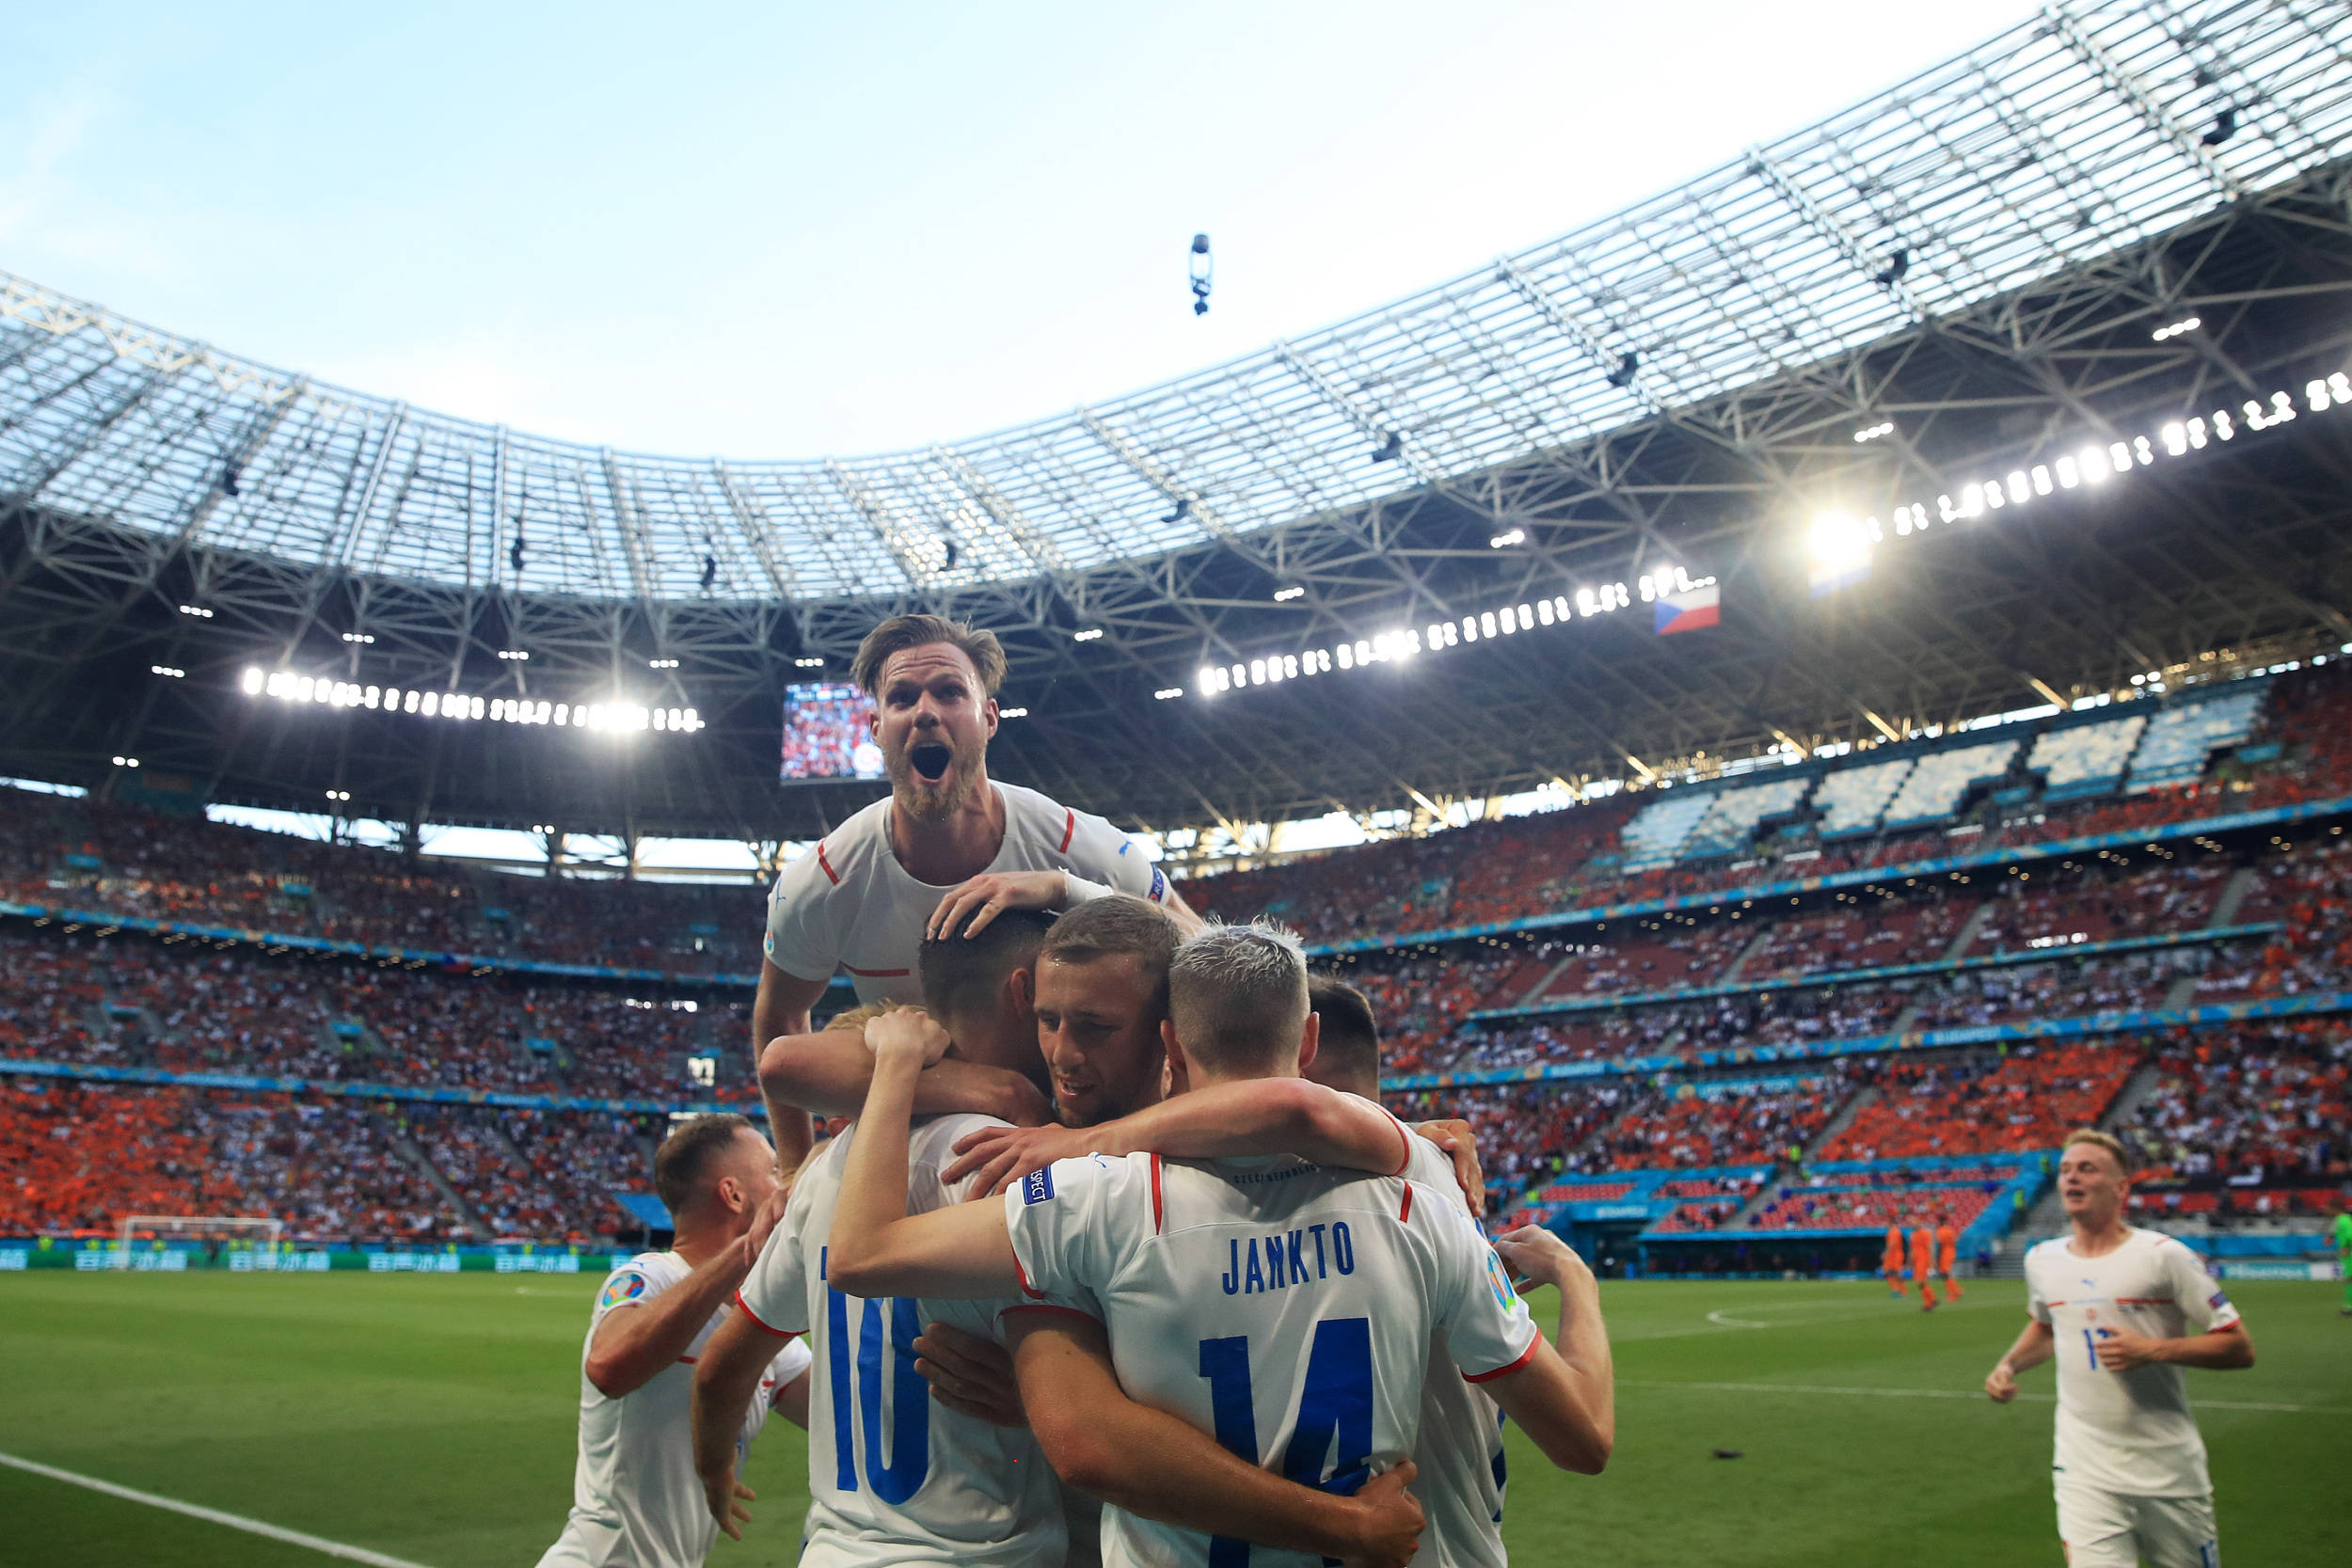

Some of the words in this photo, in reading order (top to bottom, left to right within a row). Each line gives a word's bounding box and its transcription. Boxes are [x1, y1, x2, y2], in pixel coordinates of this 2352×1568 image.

[820, 1245, 930, 1505] 10
[1222, 1221, 1356, 1295] JANKTO
[1199, 1317, 1374, 1568] 14
